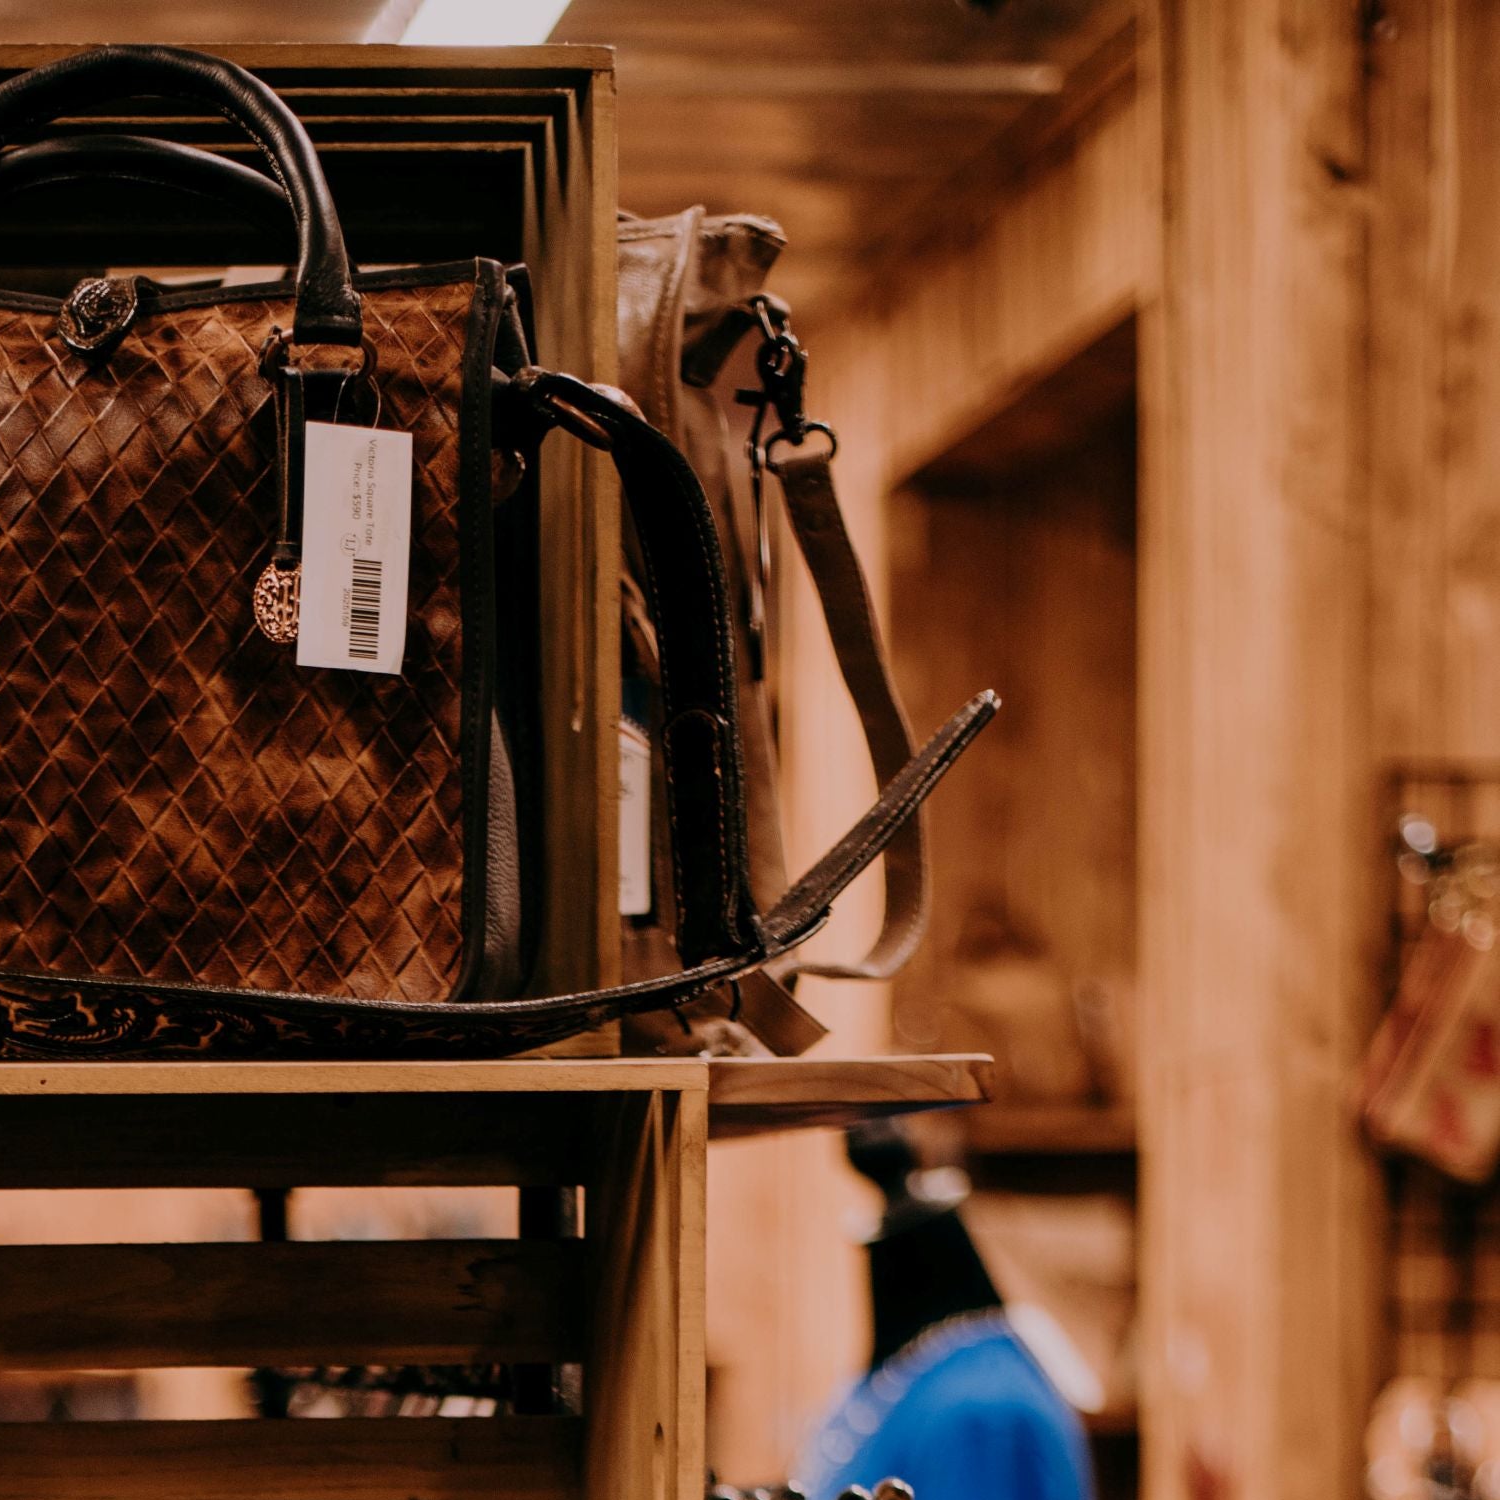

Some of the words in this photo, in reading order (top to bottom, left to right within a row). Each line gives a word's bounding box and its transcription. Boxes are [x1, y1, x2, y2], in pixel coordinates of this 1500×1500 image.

[367, 439, 378, 479] Victoria
[353, 462, 362, 491] Price:
[352, 494, 361, 520] $590
[364, 482, 377, 519] Square
[365, 522, 375, 546] Tote
